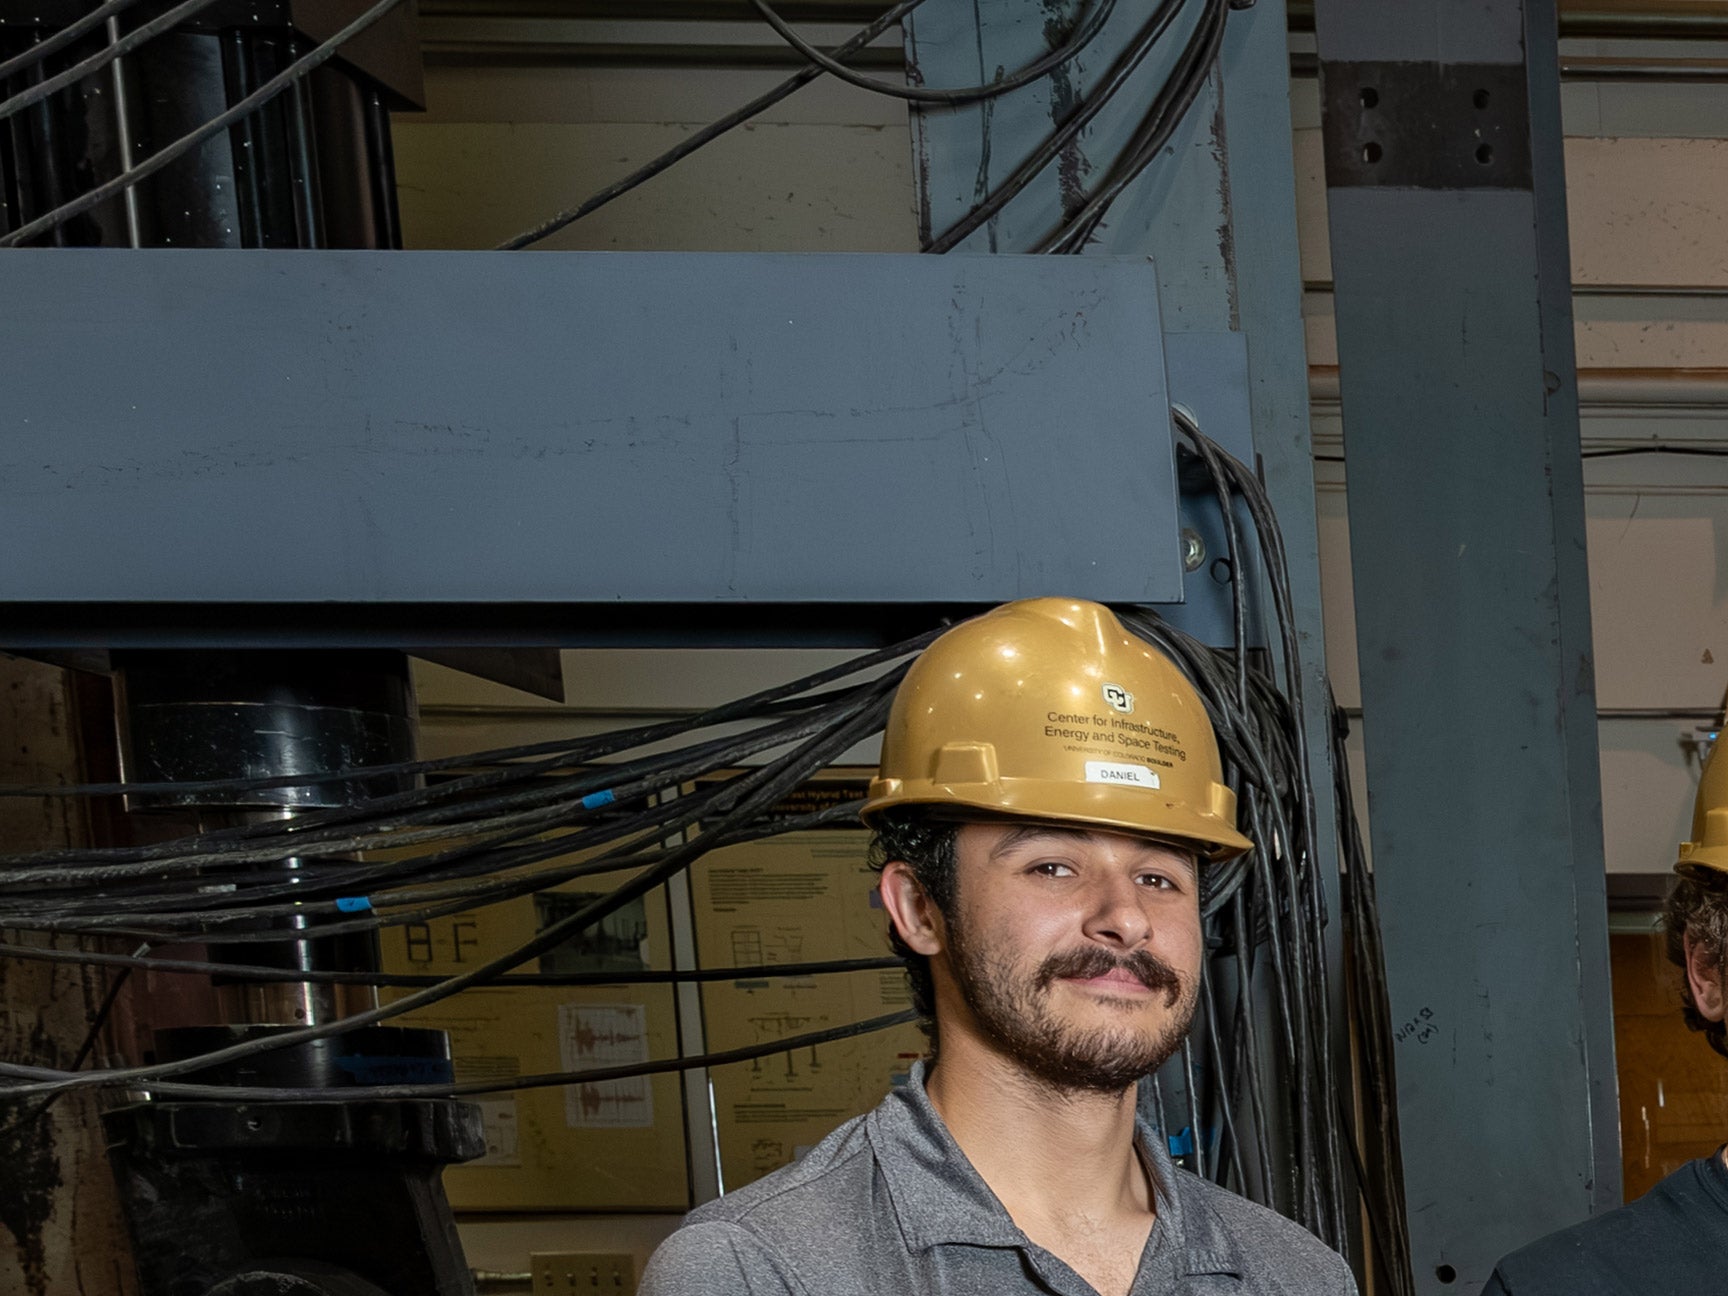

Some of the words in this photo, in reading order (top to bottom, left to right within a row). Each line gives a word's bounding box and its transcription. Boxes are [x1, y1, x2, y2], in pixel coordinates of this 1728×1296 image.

[1044, 725, 1089, 742] Energy
[1092, 730, 1115, 743] and
[1117, 733, 1151, 750] Space
[1154, 740, 1186, 762] Testing
[1047, 711, 1089, 725] Center
[1093, 714, 1107, 726] for
[1111, 717, 1180, 744] Infrastructure,
[1100, 769, 1140, 782] DANIEL
